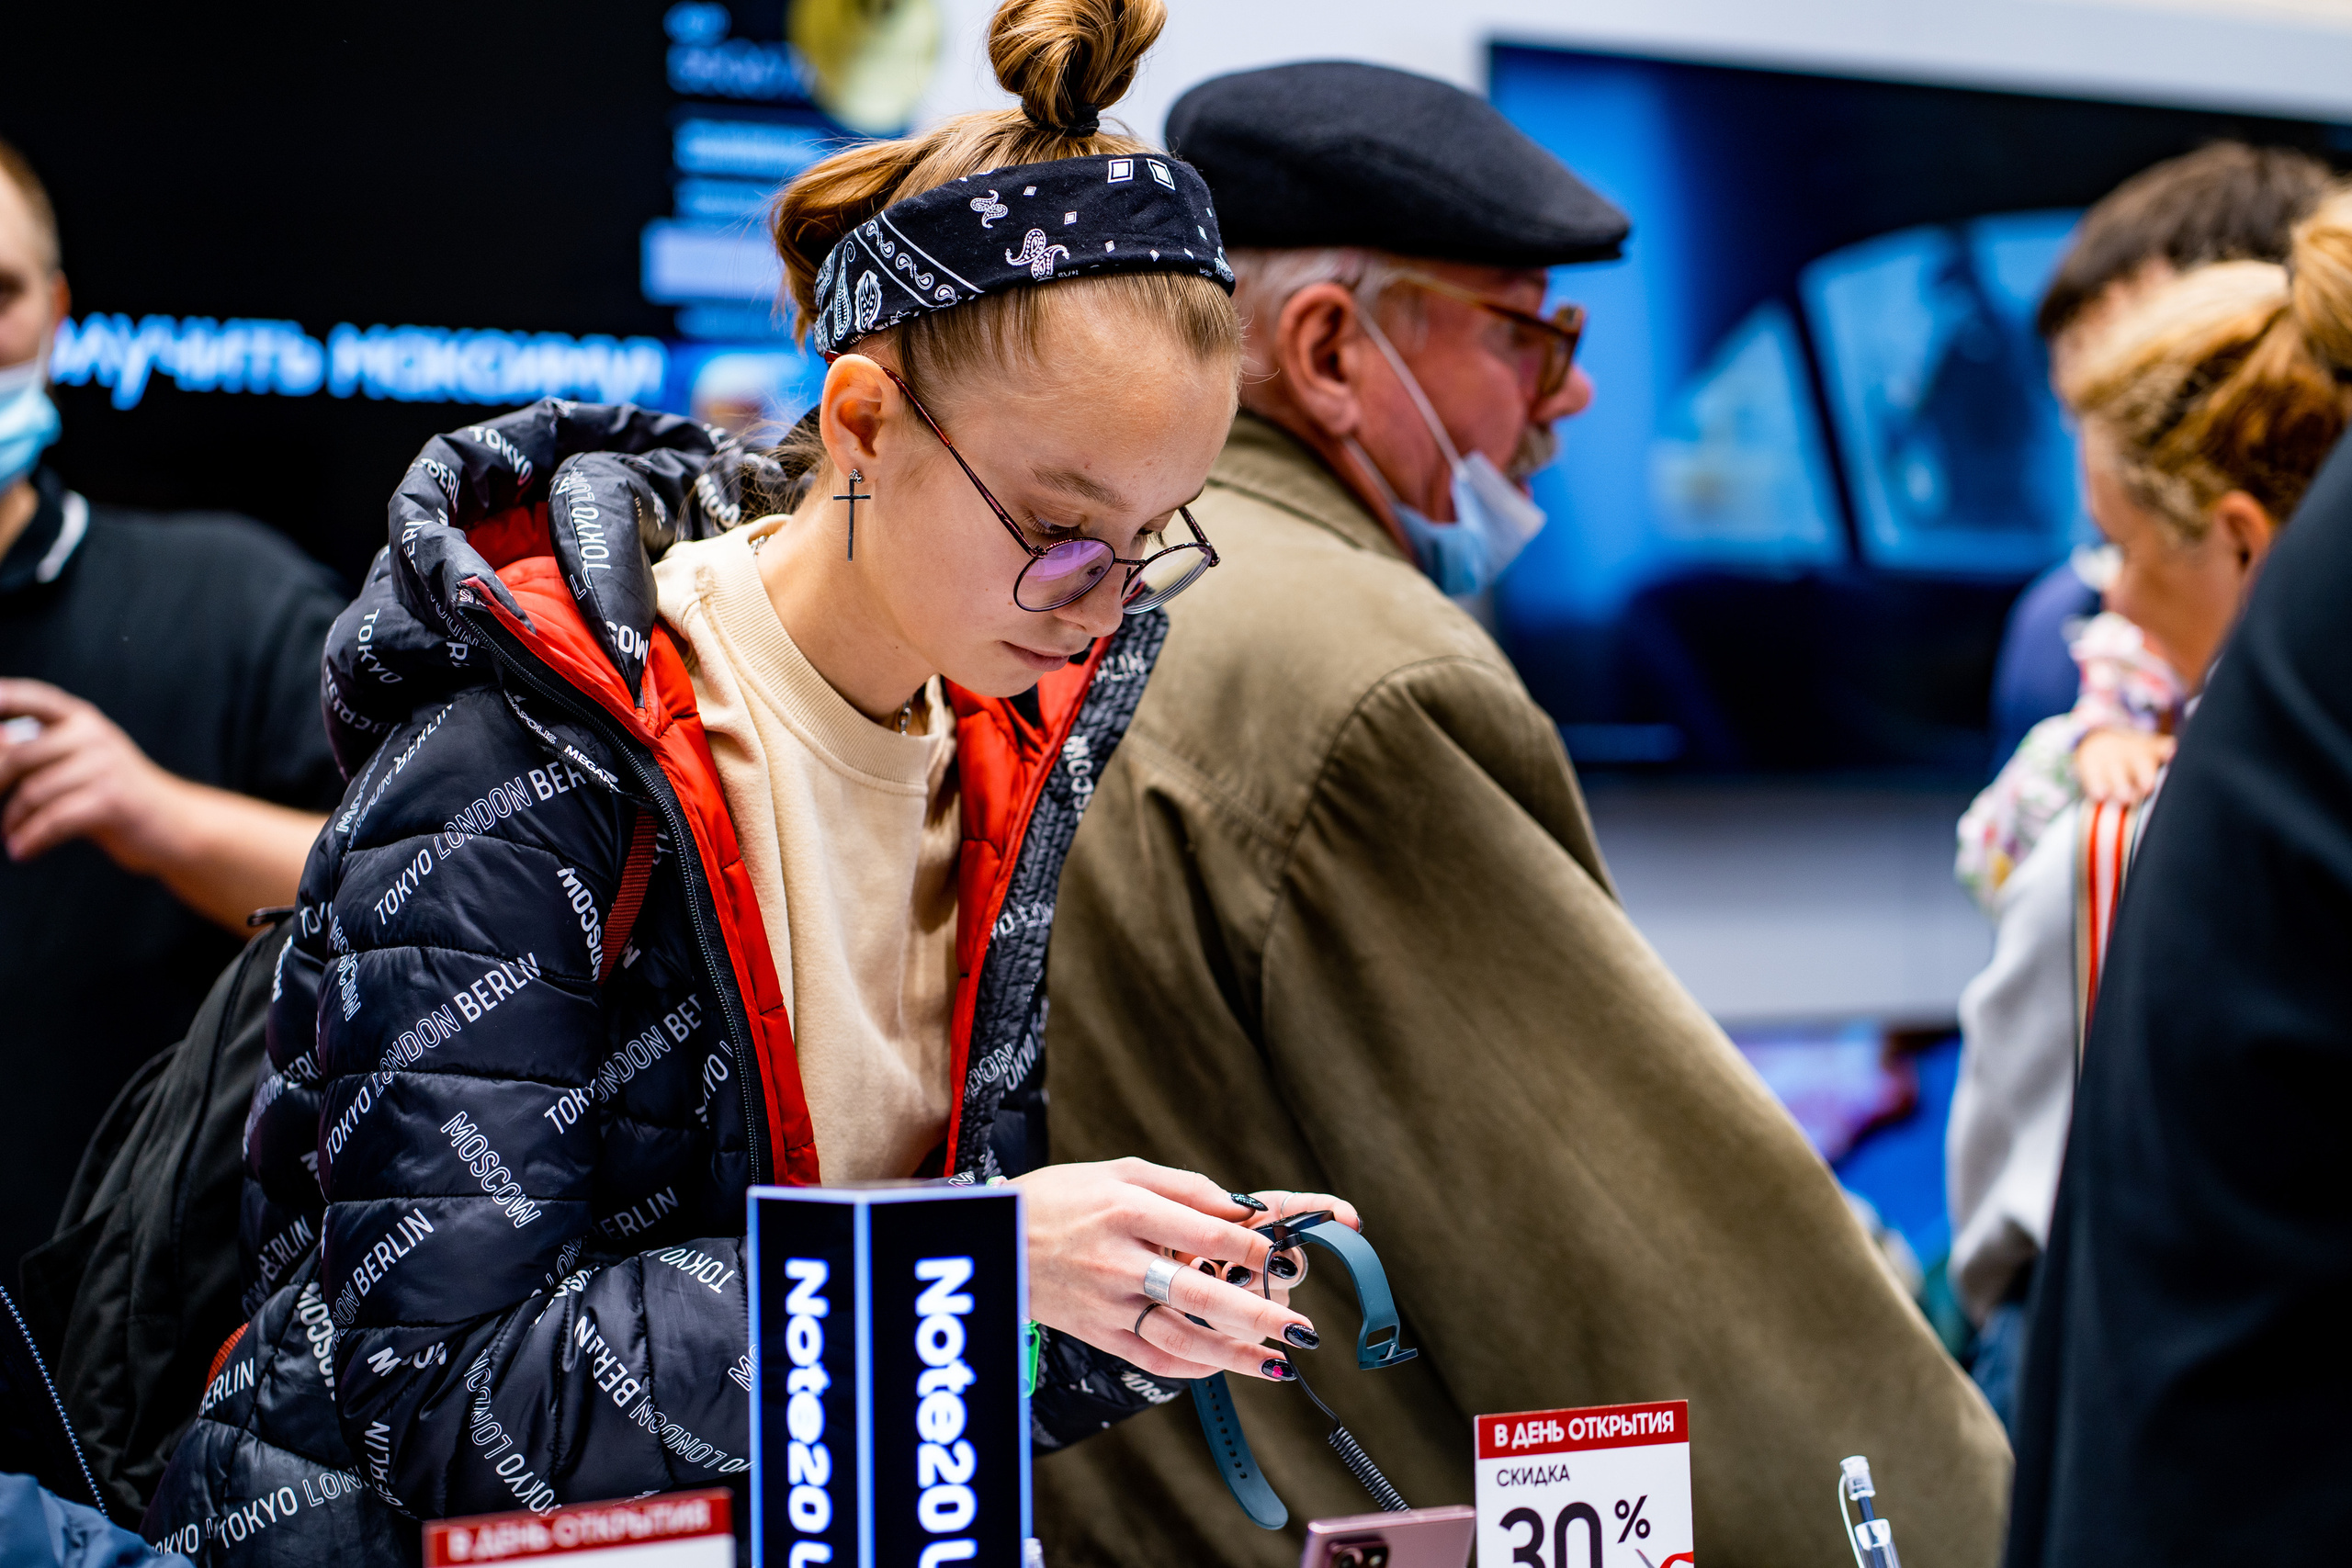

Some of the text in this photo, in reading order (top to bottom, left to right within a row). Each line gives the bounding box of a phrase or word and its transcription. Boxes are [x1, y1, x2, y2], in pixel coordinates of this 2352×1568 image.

[467, 425, 533, 487] TOKYO
[570, 505, 612, 570] TOKYO
[356, 607, 403, 684] TOKYO
[374, 848, 434, 926] TOKYO
[434, 776, 533, 861] LONDON
[325, 1086, 371, 1165] TOKYO
[371, 1003, 462, 1099] LONDON
[453, 952, 542, 1023] BERLN
[965, 1043, 1014, 1102] DON
[440, 1110, 542, 1229] MOSCOW
[591, 1186, 680, 1240] ERLIN
[352, 1207, 435, 1297] BERLIN
[659, 1247, 735, 1294] TOKYO
[785, 1258, 831, 1534] Note20
[914, 1256, 978, 1534] Note20
[1494, 1410, 1675, 1450] В ДЕНЬ ОТКРЫТИЯ
[365, 1420, 404, 1506] BERLIN
[628, 1395, 728, 1469] LONDON
[1497, 1463, 1571, 1487] СКИДКА
[219, 1486, 299, 1550] TOKYO
[1498, 1495, 1652, 1568] 30 %
